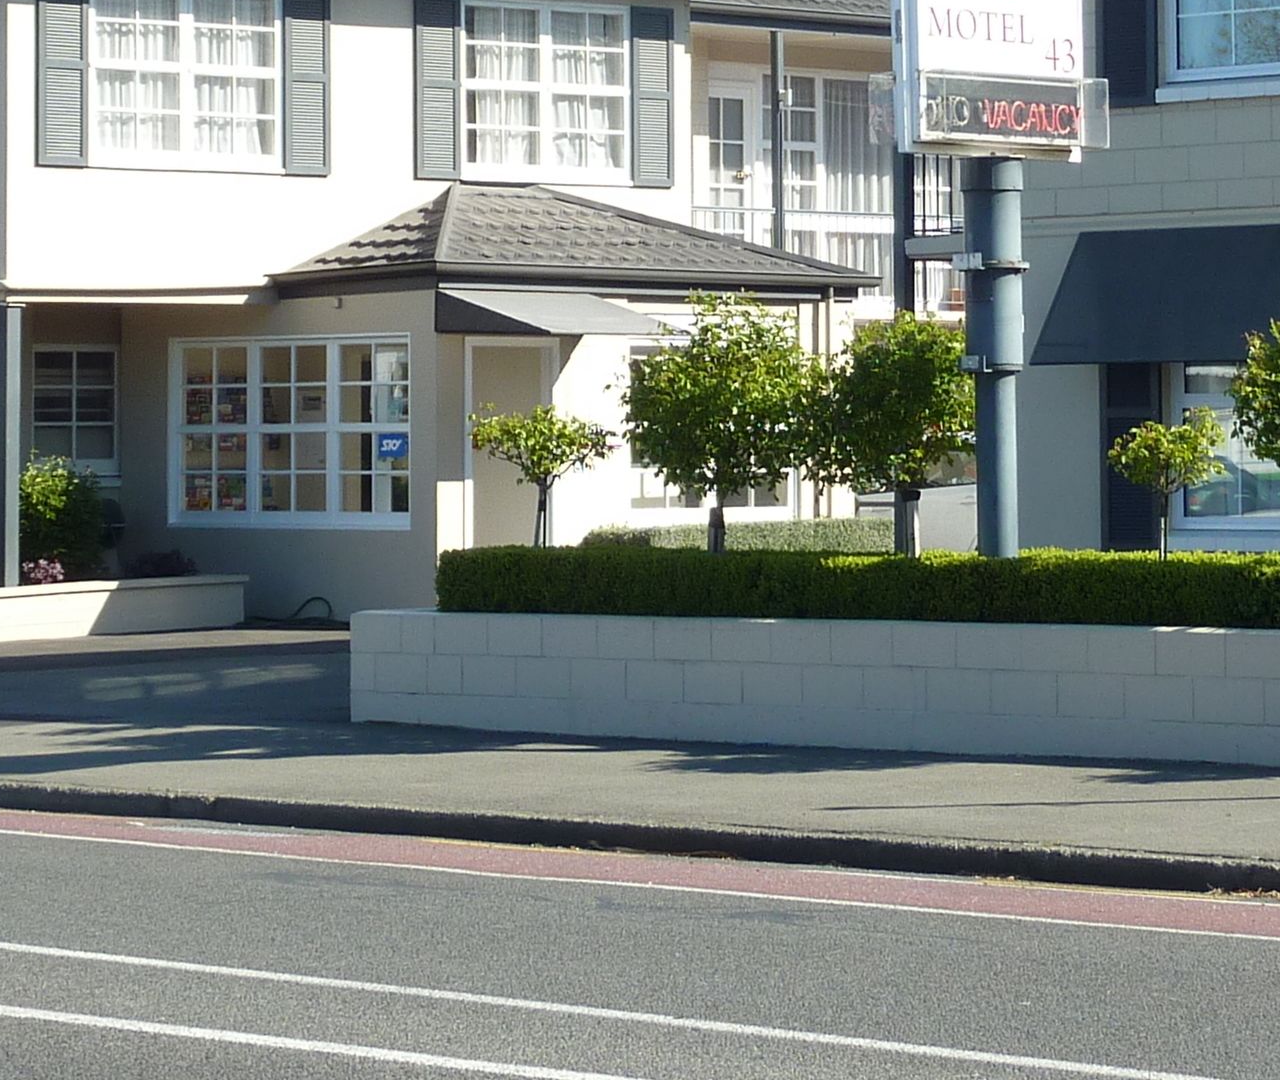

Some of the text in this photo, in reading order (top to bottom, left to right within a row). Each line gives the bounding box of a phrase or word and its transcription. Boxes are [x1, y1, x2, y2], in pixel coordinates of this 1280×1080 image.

[928, 6, 1035, 45] MOTEL
[1044, 37, 1076, 74] 43
[983, 98, 1084, 135] VACANCY
